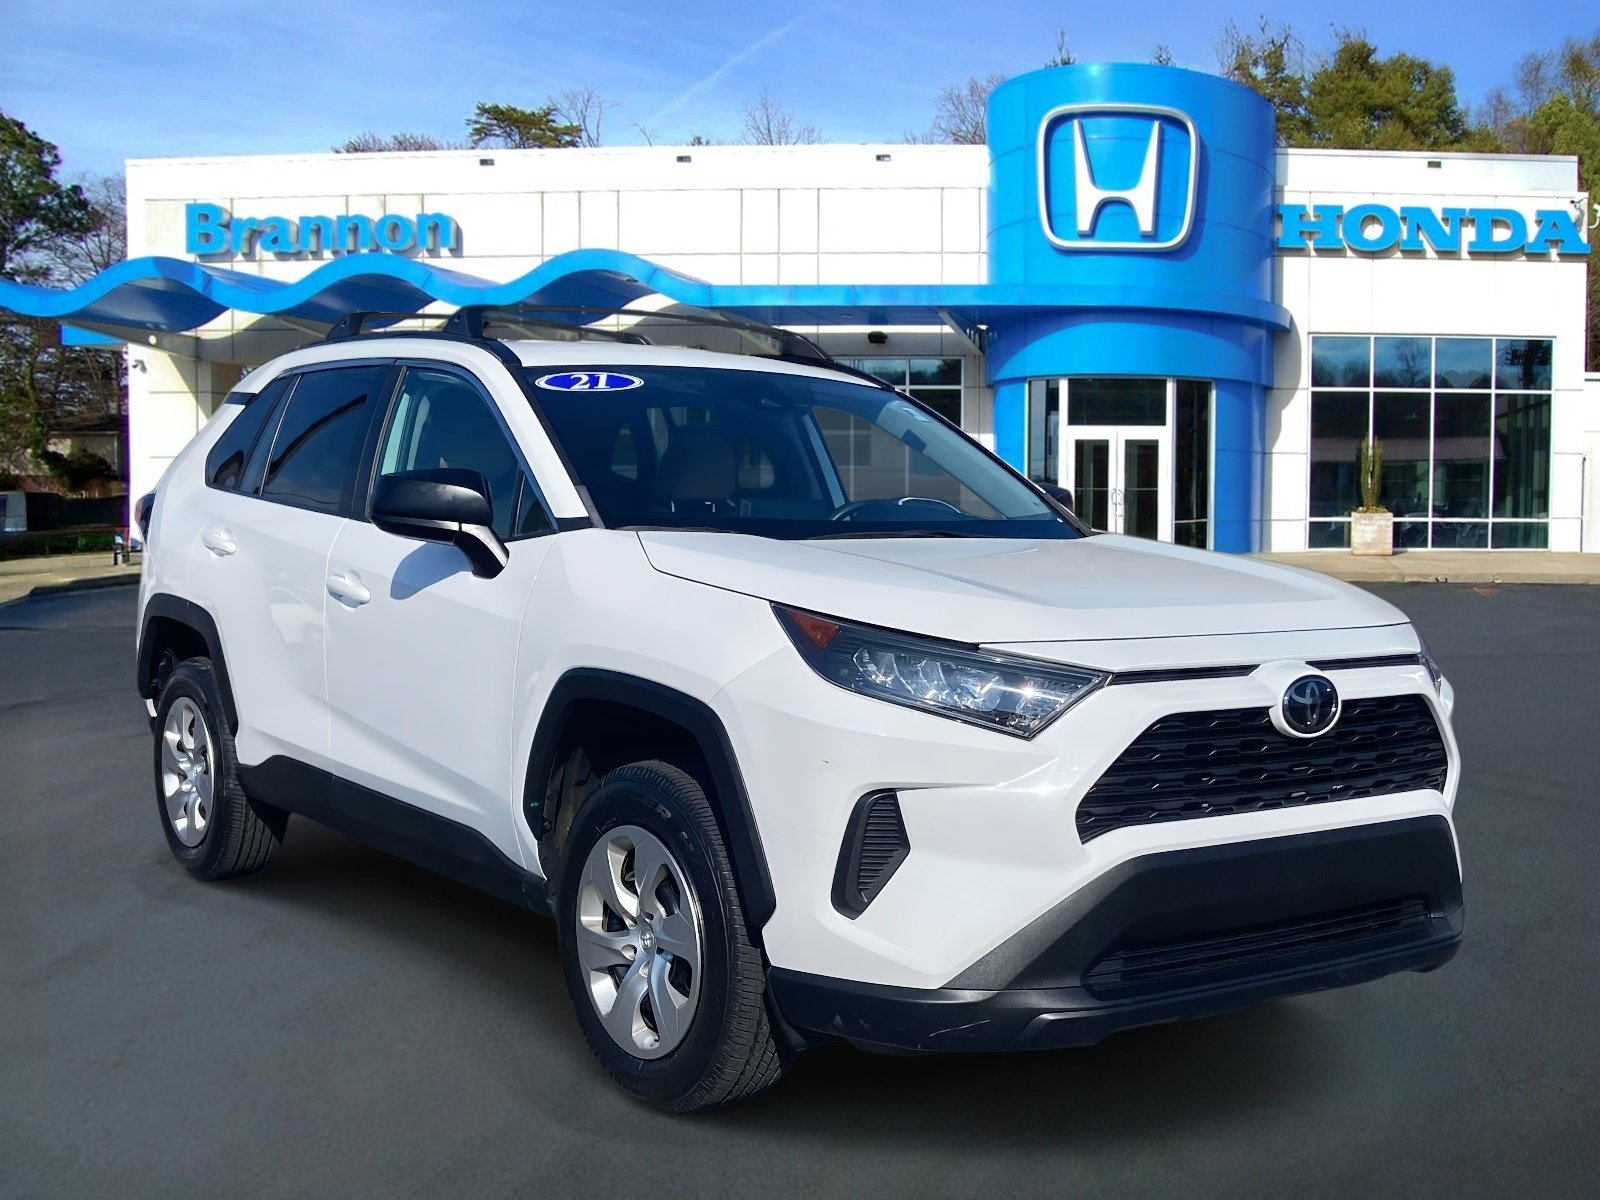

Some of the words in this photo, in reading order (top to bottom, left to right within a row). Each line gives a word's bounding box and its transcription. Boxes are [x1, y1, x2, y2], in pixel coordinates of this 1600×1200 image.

[185, 202, 459, 256] Brannon
[1277, 203, 1592, 256] HONDA
[569, 373, 611, 390] 21
